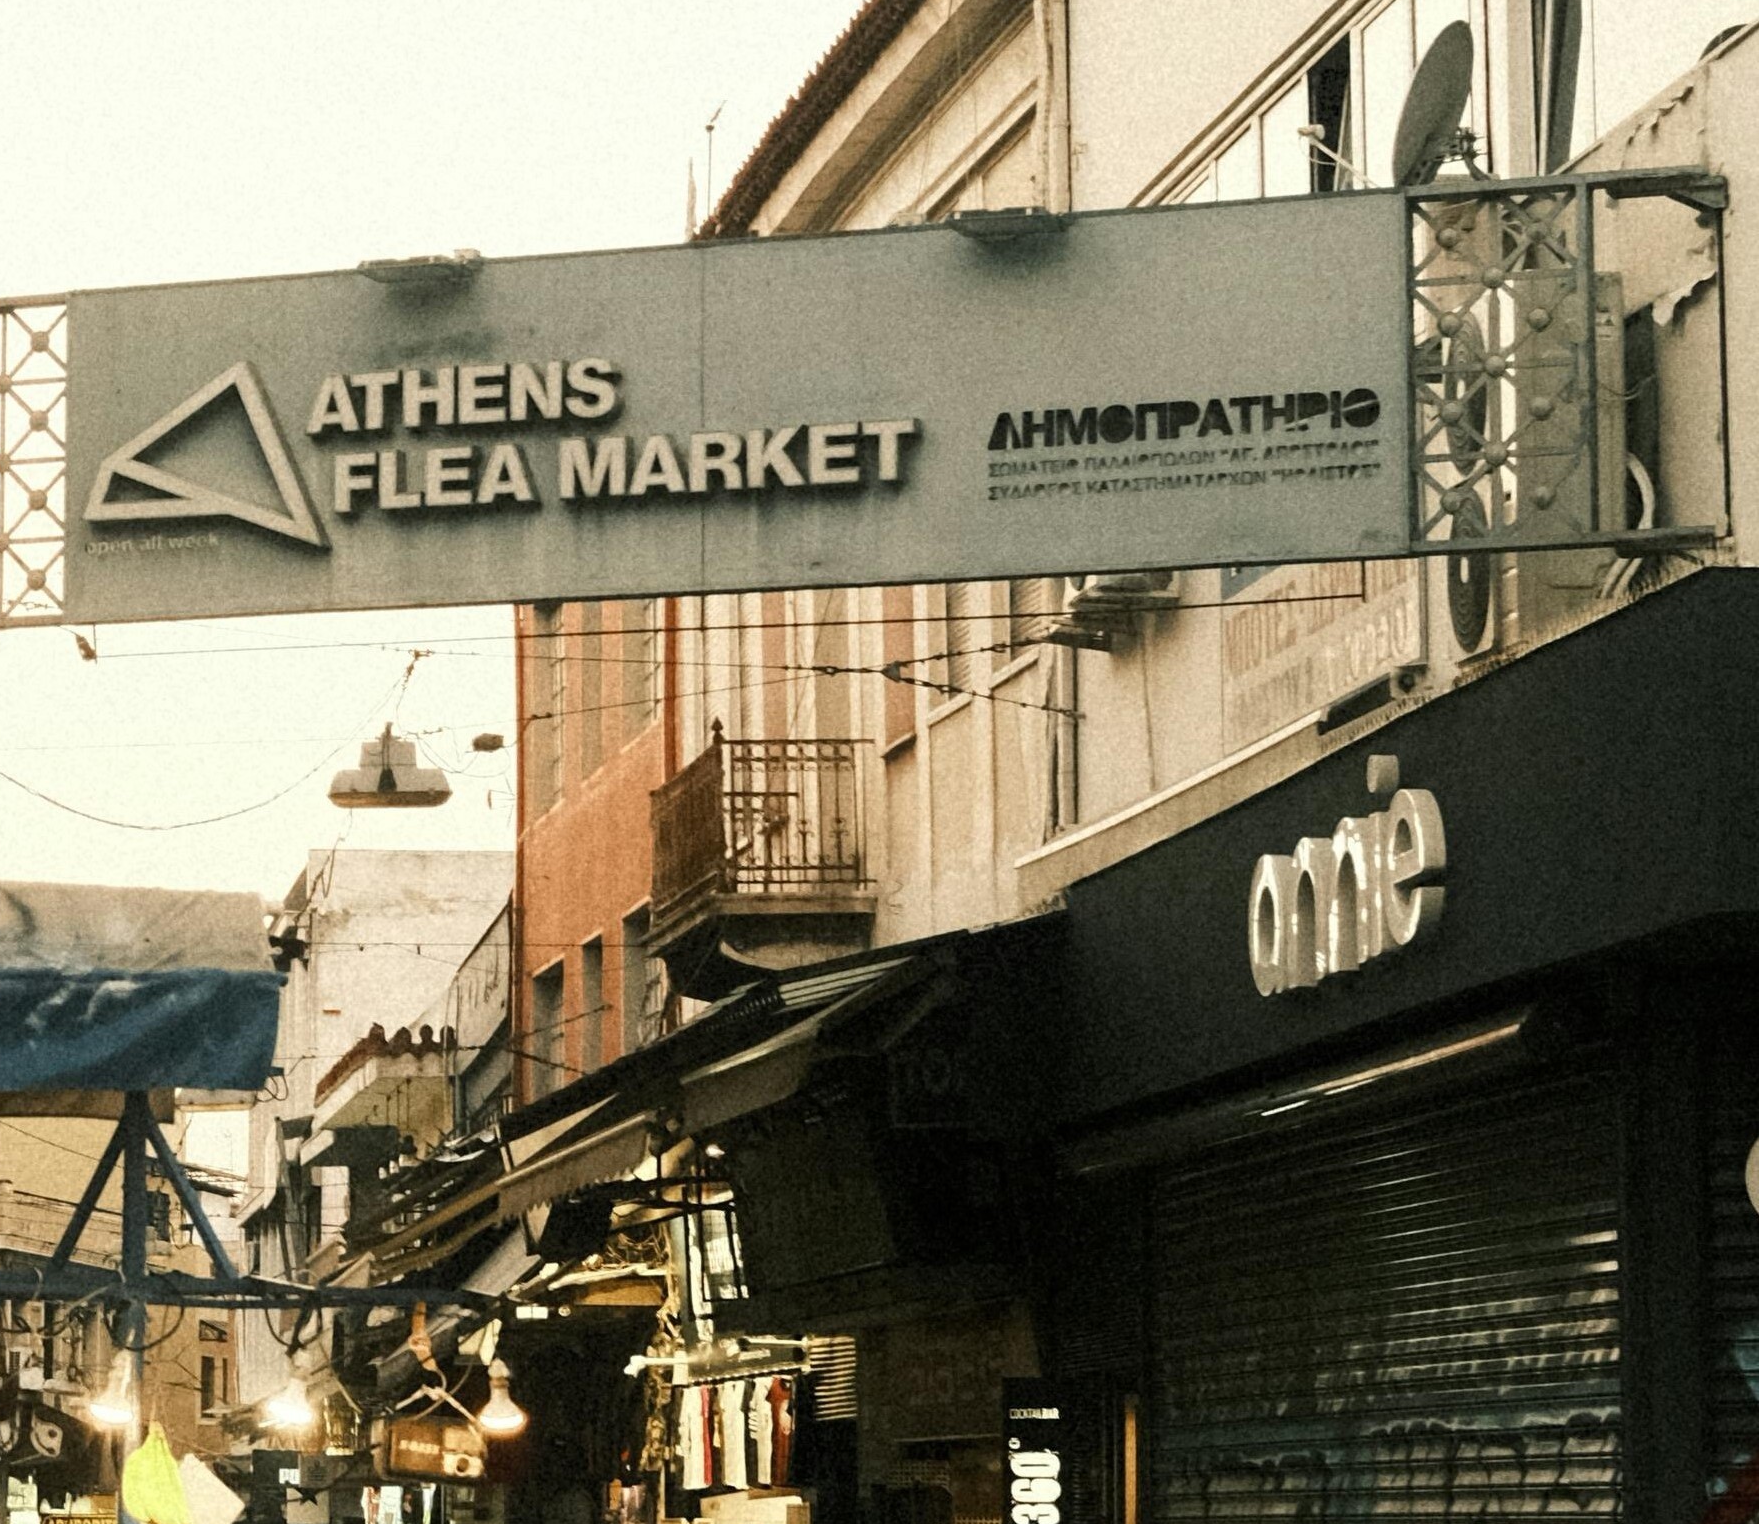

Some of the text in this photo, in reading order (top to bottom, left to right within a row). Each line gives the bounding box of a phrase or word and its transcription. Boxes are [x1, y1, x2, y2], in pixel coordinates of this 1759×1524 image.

[307, 356, 621, 437] ATHENS
[987, 387, 1381, 451] ΔΗΜΟΠΡΑΤΗΡΙΟ
[332, 416, 919, 514] FLEA MARKET
[84, 532, 221, 559] open all week
